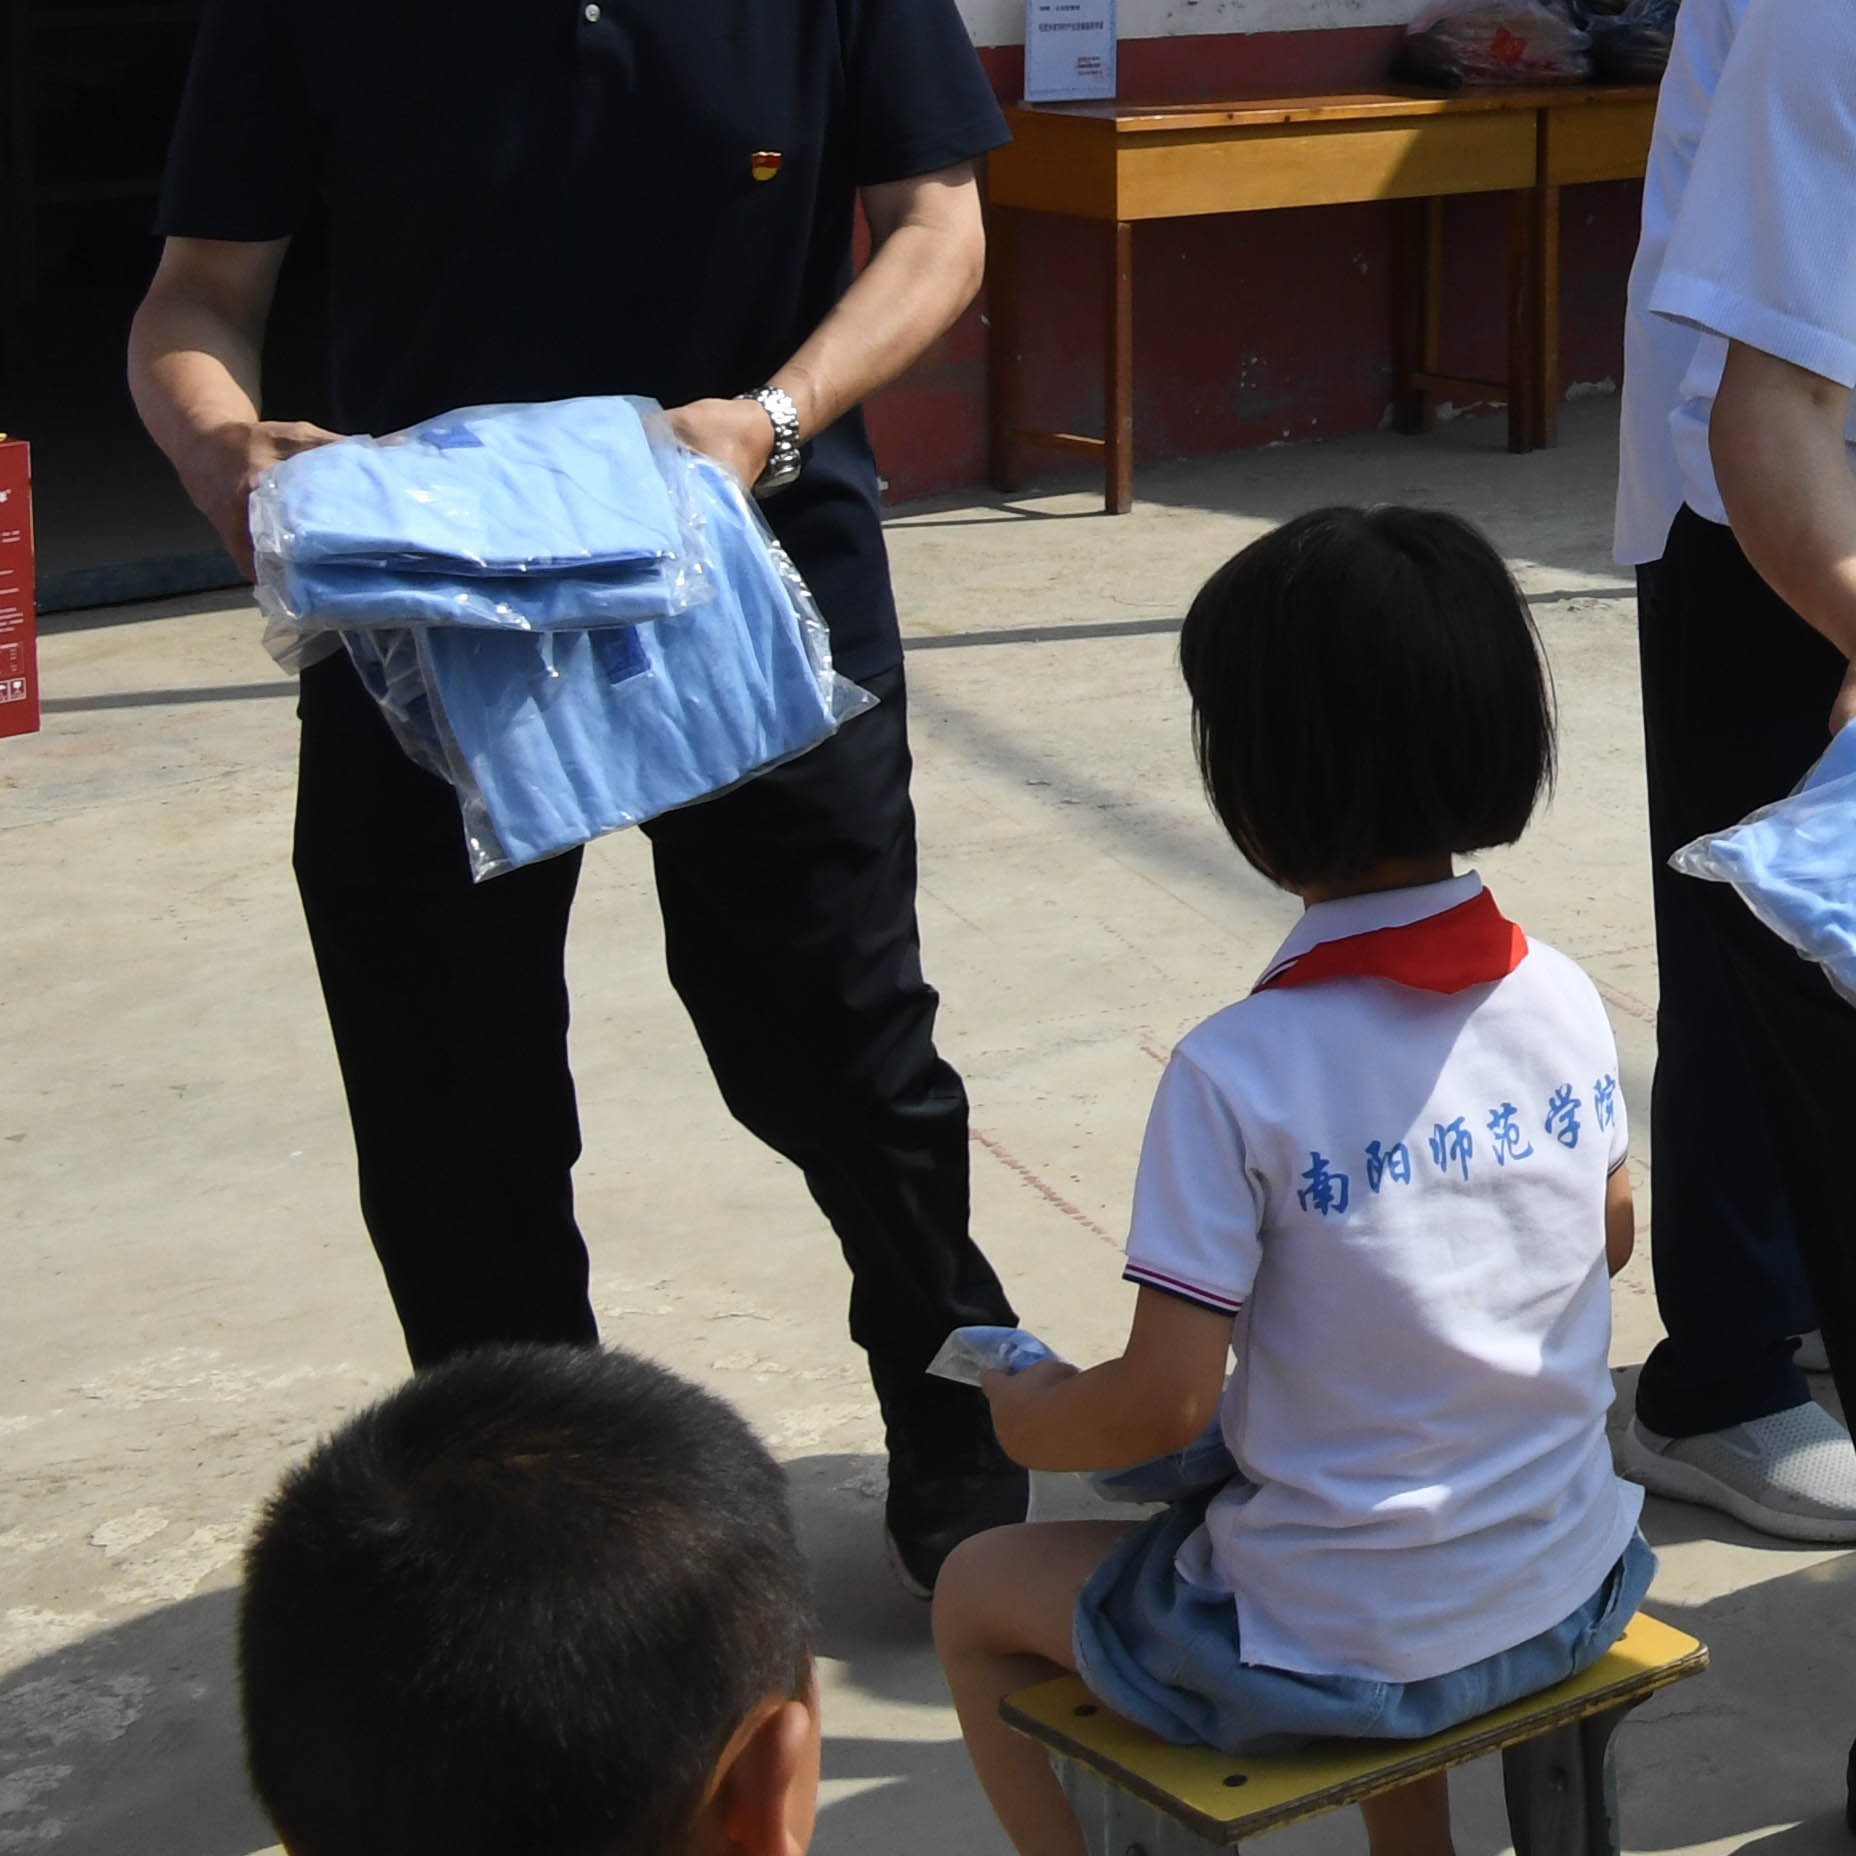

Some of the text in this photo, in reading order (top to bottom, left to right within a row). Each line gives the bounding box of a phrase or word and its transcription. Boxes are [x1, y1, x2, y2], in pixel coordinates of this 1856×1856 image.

[1298, 1073, 1617, 1216] 南阳师范学院
